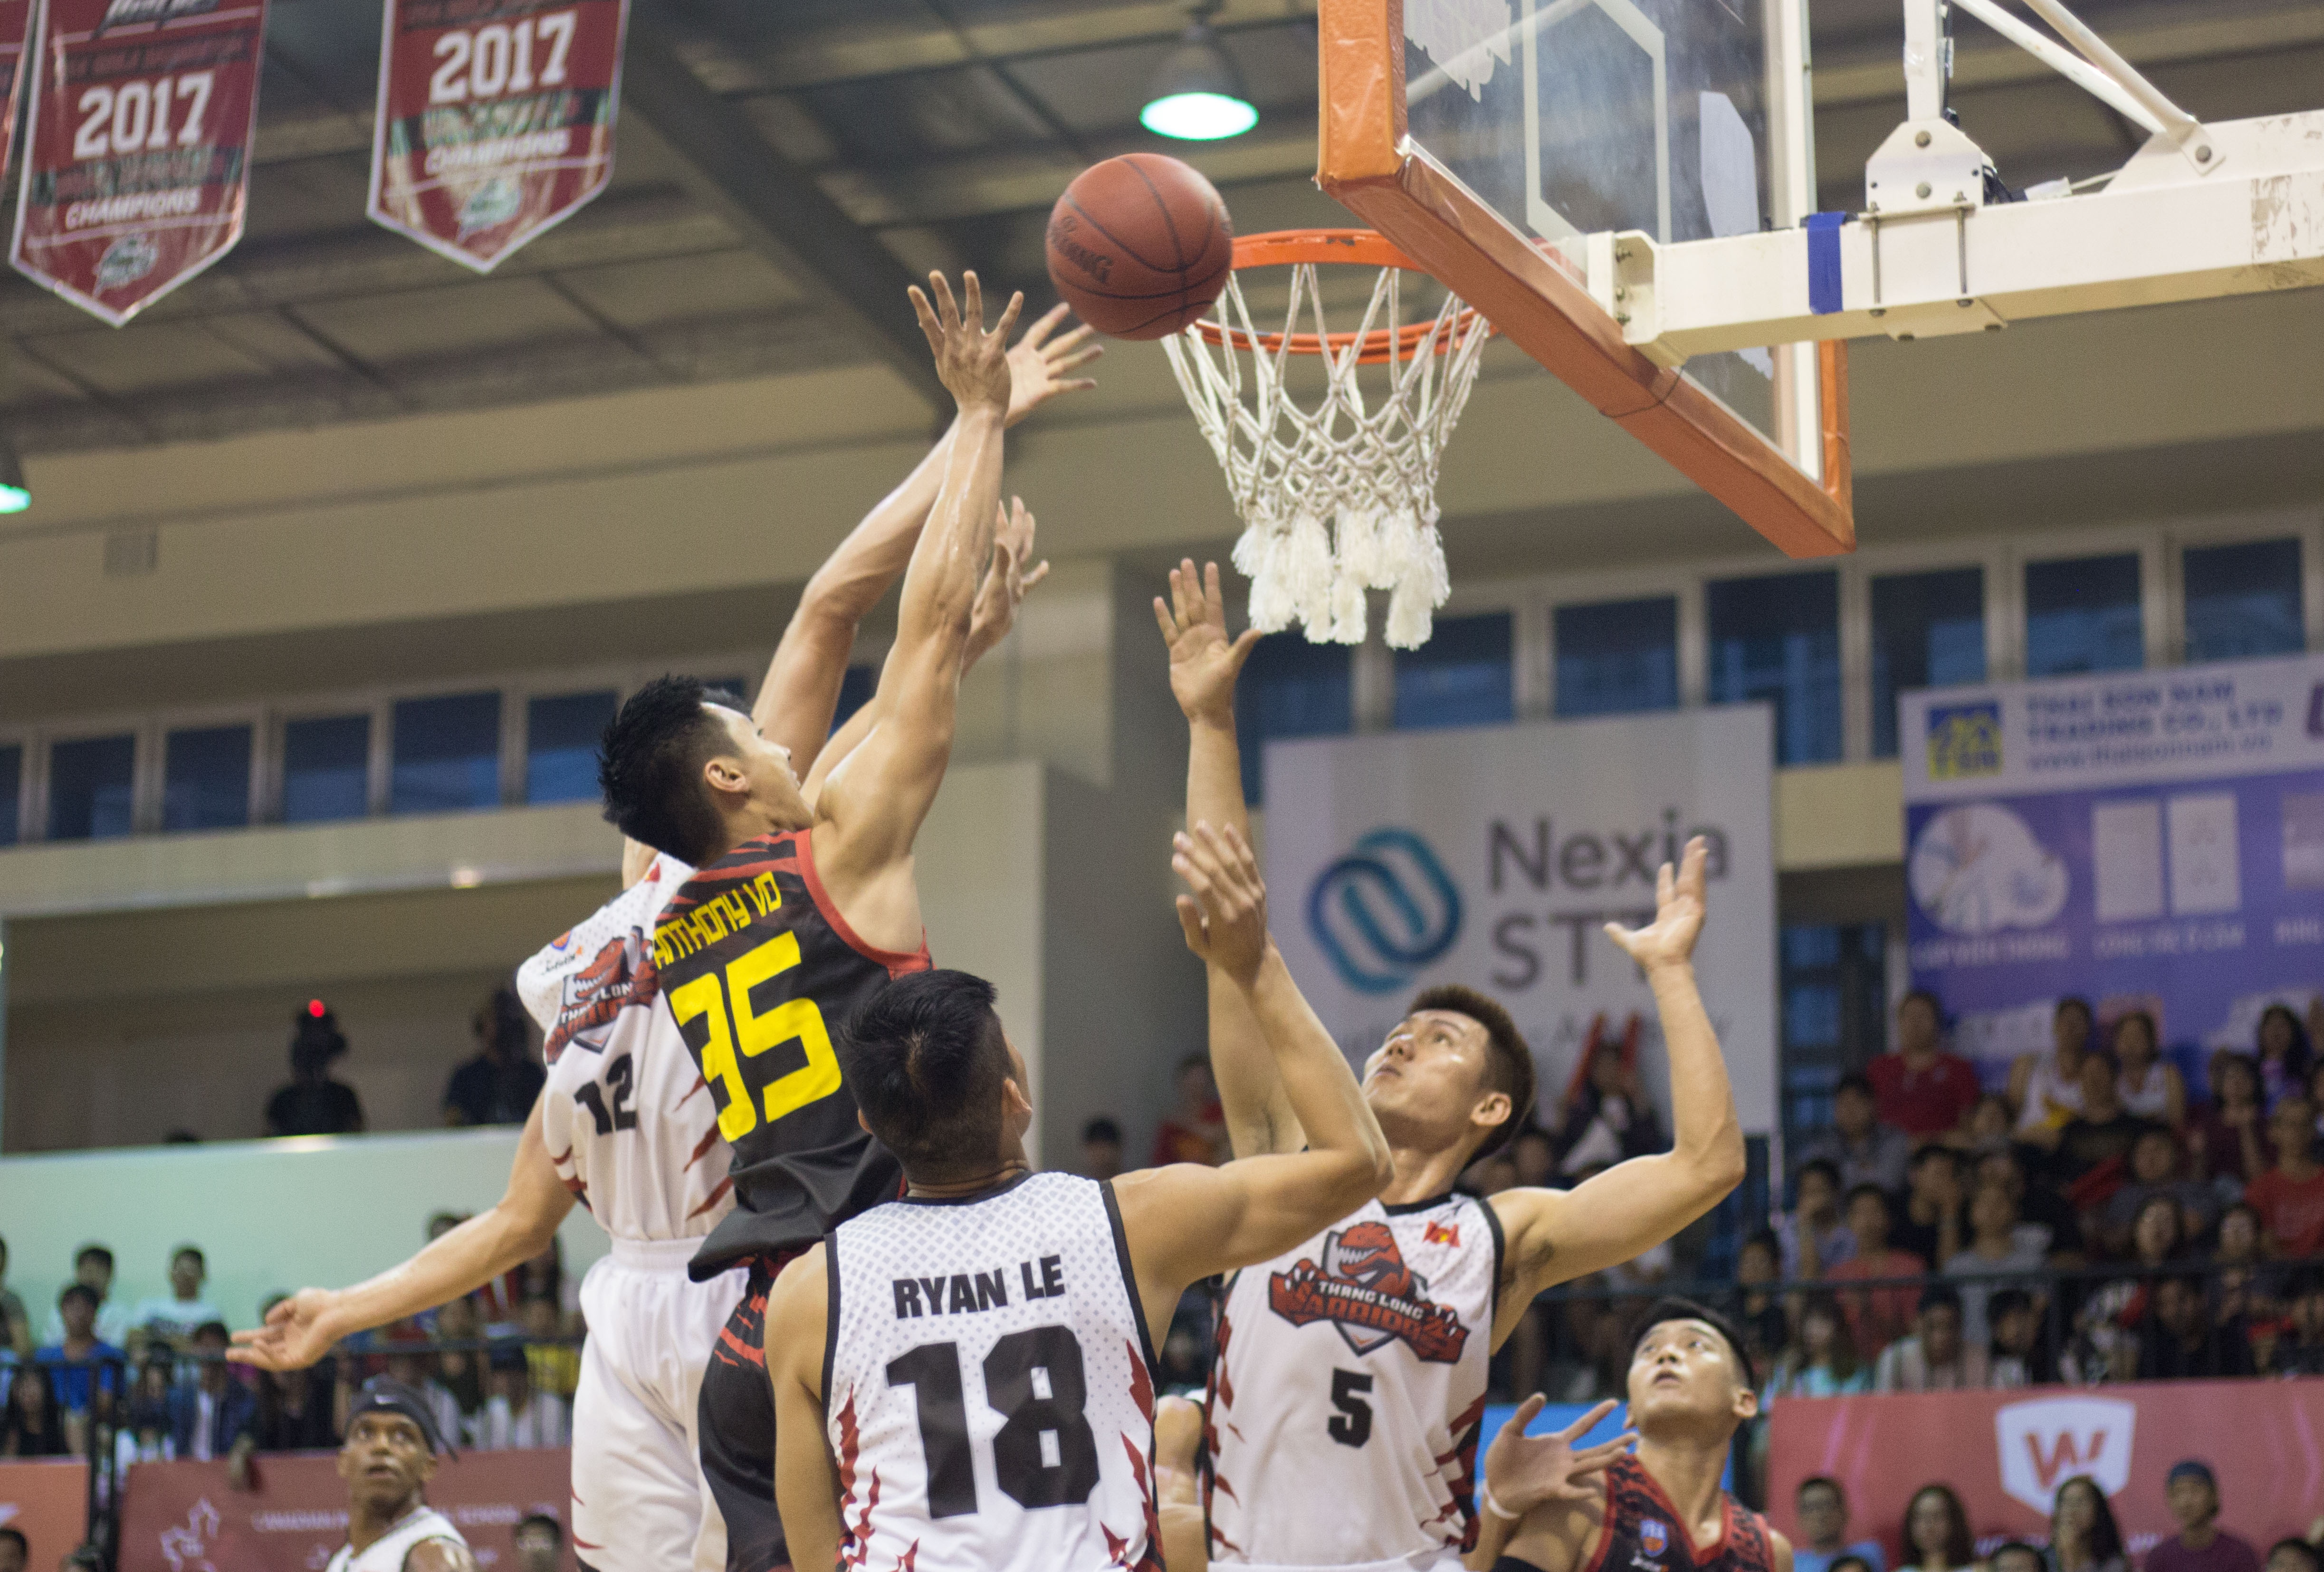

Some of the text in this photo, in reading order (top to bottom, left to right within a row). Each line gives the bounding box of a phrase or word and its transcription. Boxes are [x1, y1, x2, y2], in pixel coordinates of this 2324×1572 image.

[429, 10, 576, 105] 2017
[74, 71, 214, 160] 2017
[65, 188, 202, 229] CHAMPIONS
[1488, 808, 1731, 895] Nexia
[653, 871, 782, 970] ANTHONY VO
[600, 981, 634, 1000] LON
[670, 931, 842, 1143] 35
[574, 1053, 637, 1135] 12
[893, 1255, 1066, 1320] RYAN LE
[1318, 1280, 1425, 1321] THANG LONG
[885, 1324, 1100, 1519] 18
[1328, 1367, 1373, 1449] 5
[2023, 1429, 2109, 1490] W
